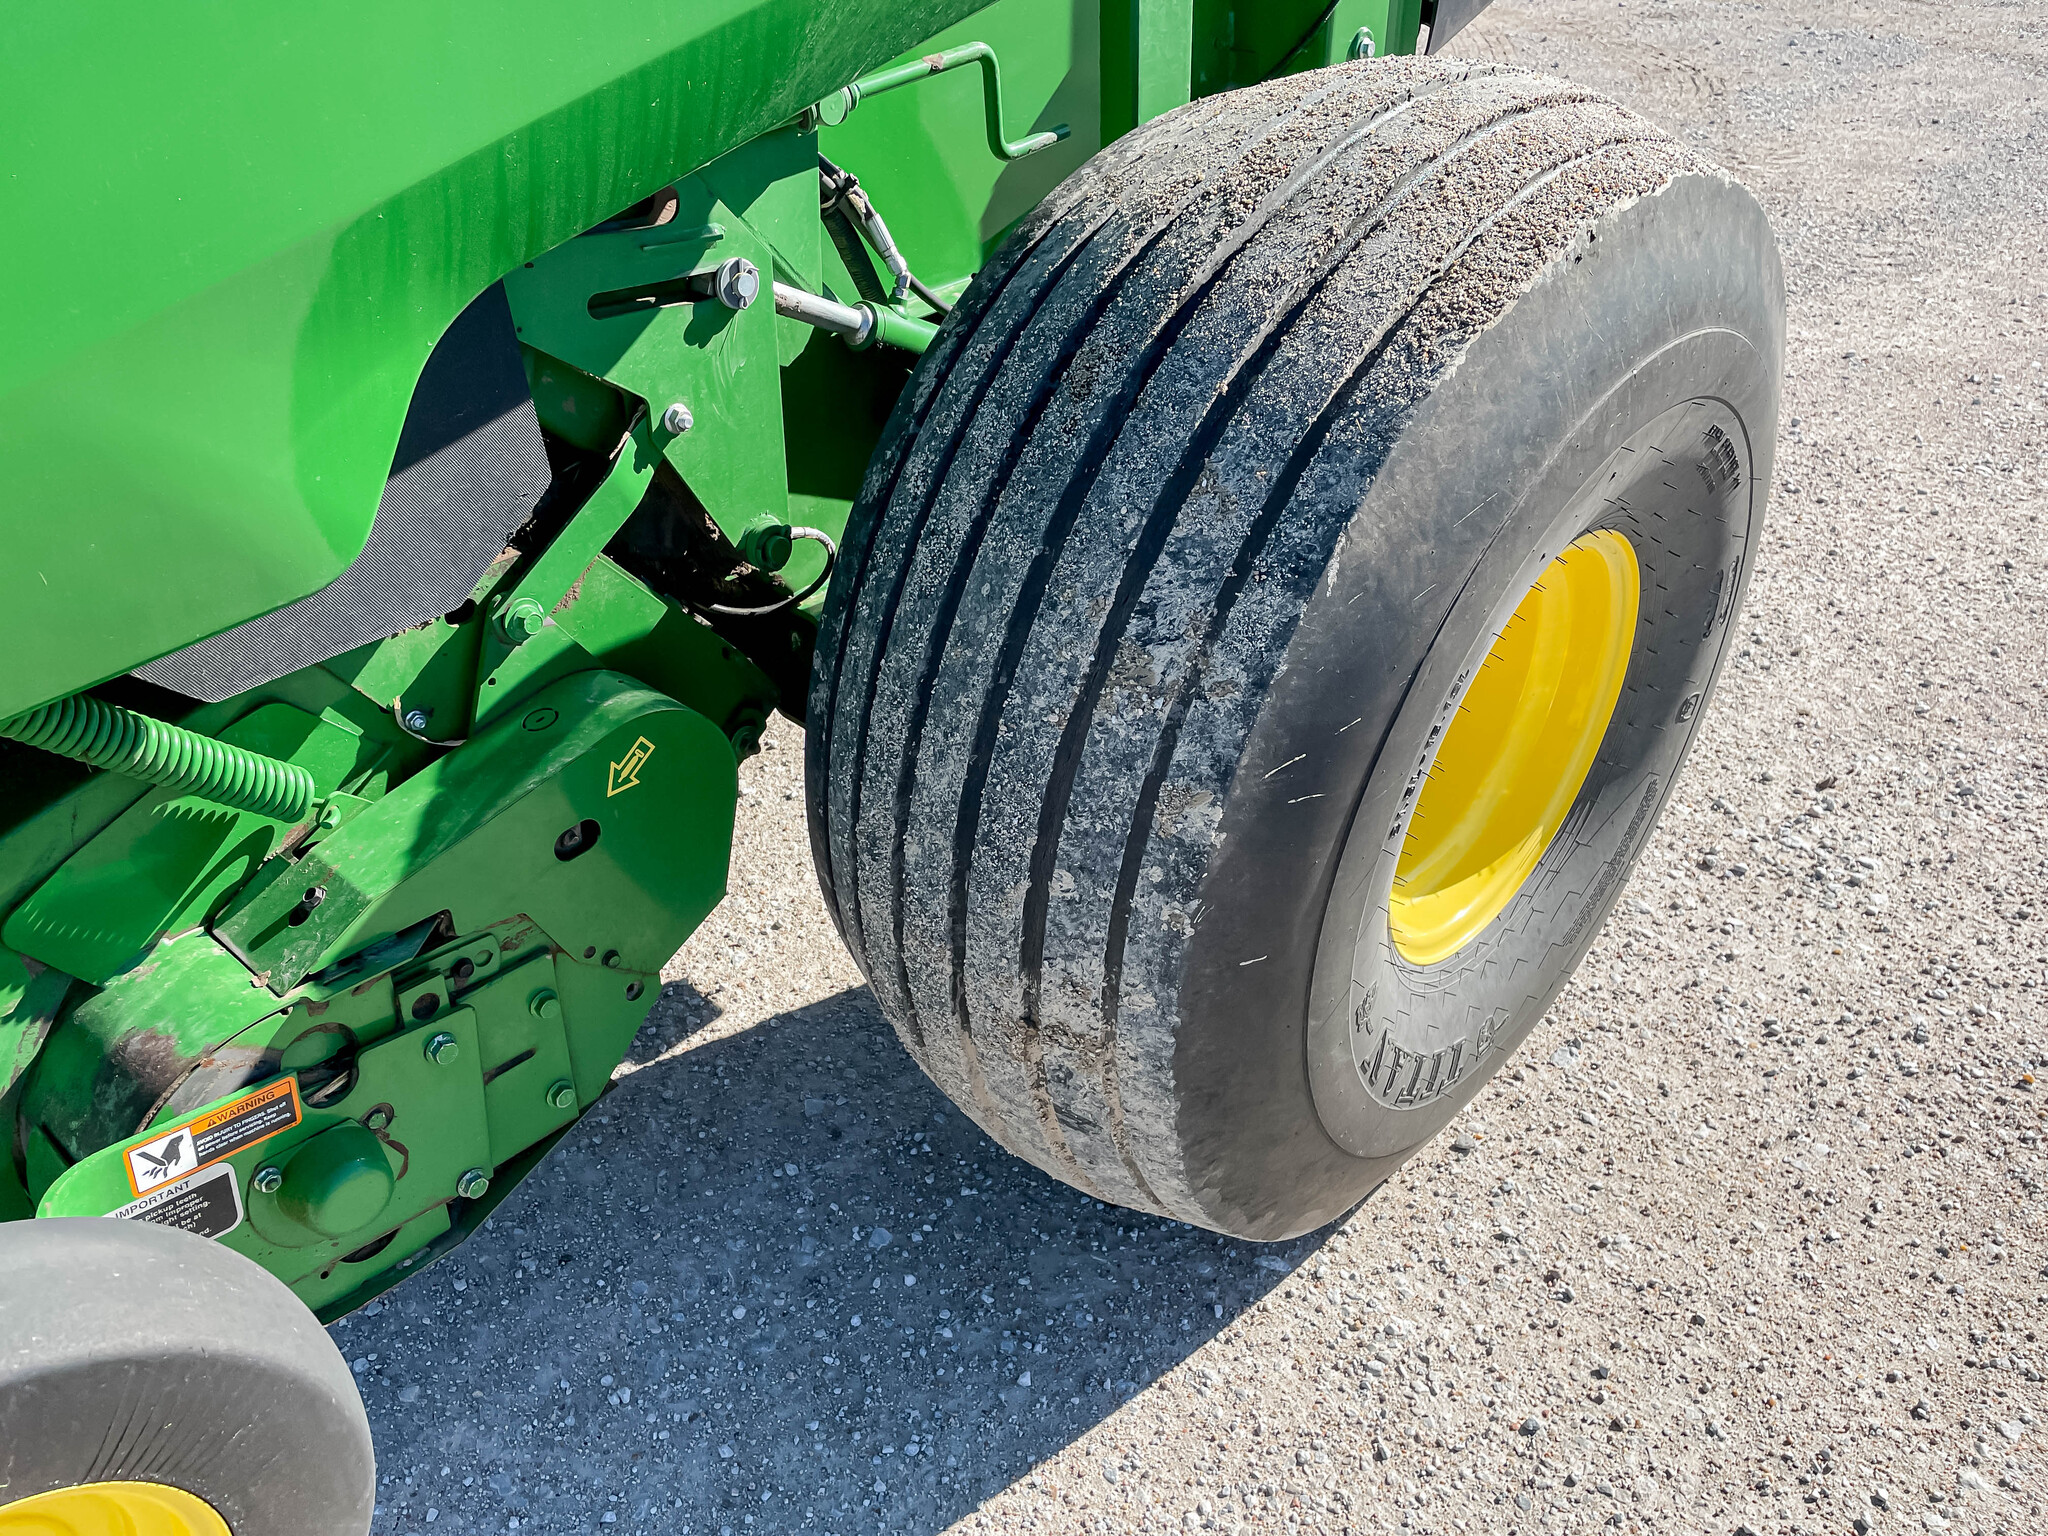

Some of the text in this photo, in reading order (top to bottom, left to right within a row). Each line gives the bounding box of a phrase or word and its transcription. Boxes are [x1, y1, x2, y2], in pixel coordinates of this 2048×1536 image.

[217, 1091, 275, 1122] WARNING
[197, 1135, 213, 1146] AVOID
[214, 1126, 233, 1138] INJURY
[199, 1147, 215, 1157] hands
[216, 1141, 229, 1149] clear
[229, 1134, 243, 1143] when
[244, 1124, 265, 1136] machine
[271, 1112, 292, 1124] running.
[205, 1138, 220, 1149] power
[222, 1130, 238, 1141] before
[264, 1113, 277, 1122] Keep
[115, 1180, 190, 1219] IMPORTANT
[145, 1193, 197, 1222] pickup teeth
[150, 1196, 203, 1224] om improper
[180, 1201, 211, 1218] setting.
[180, 1218, 193, 1226] be
[193, 1212, 202, 1220] at
